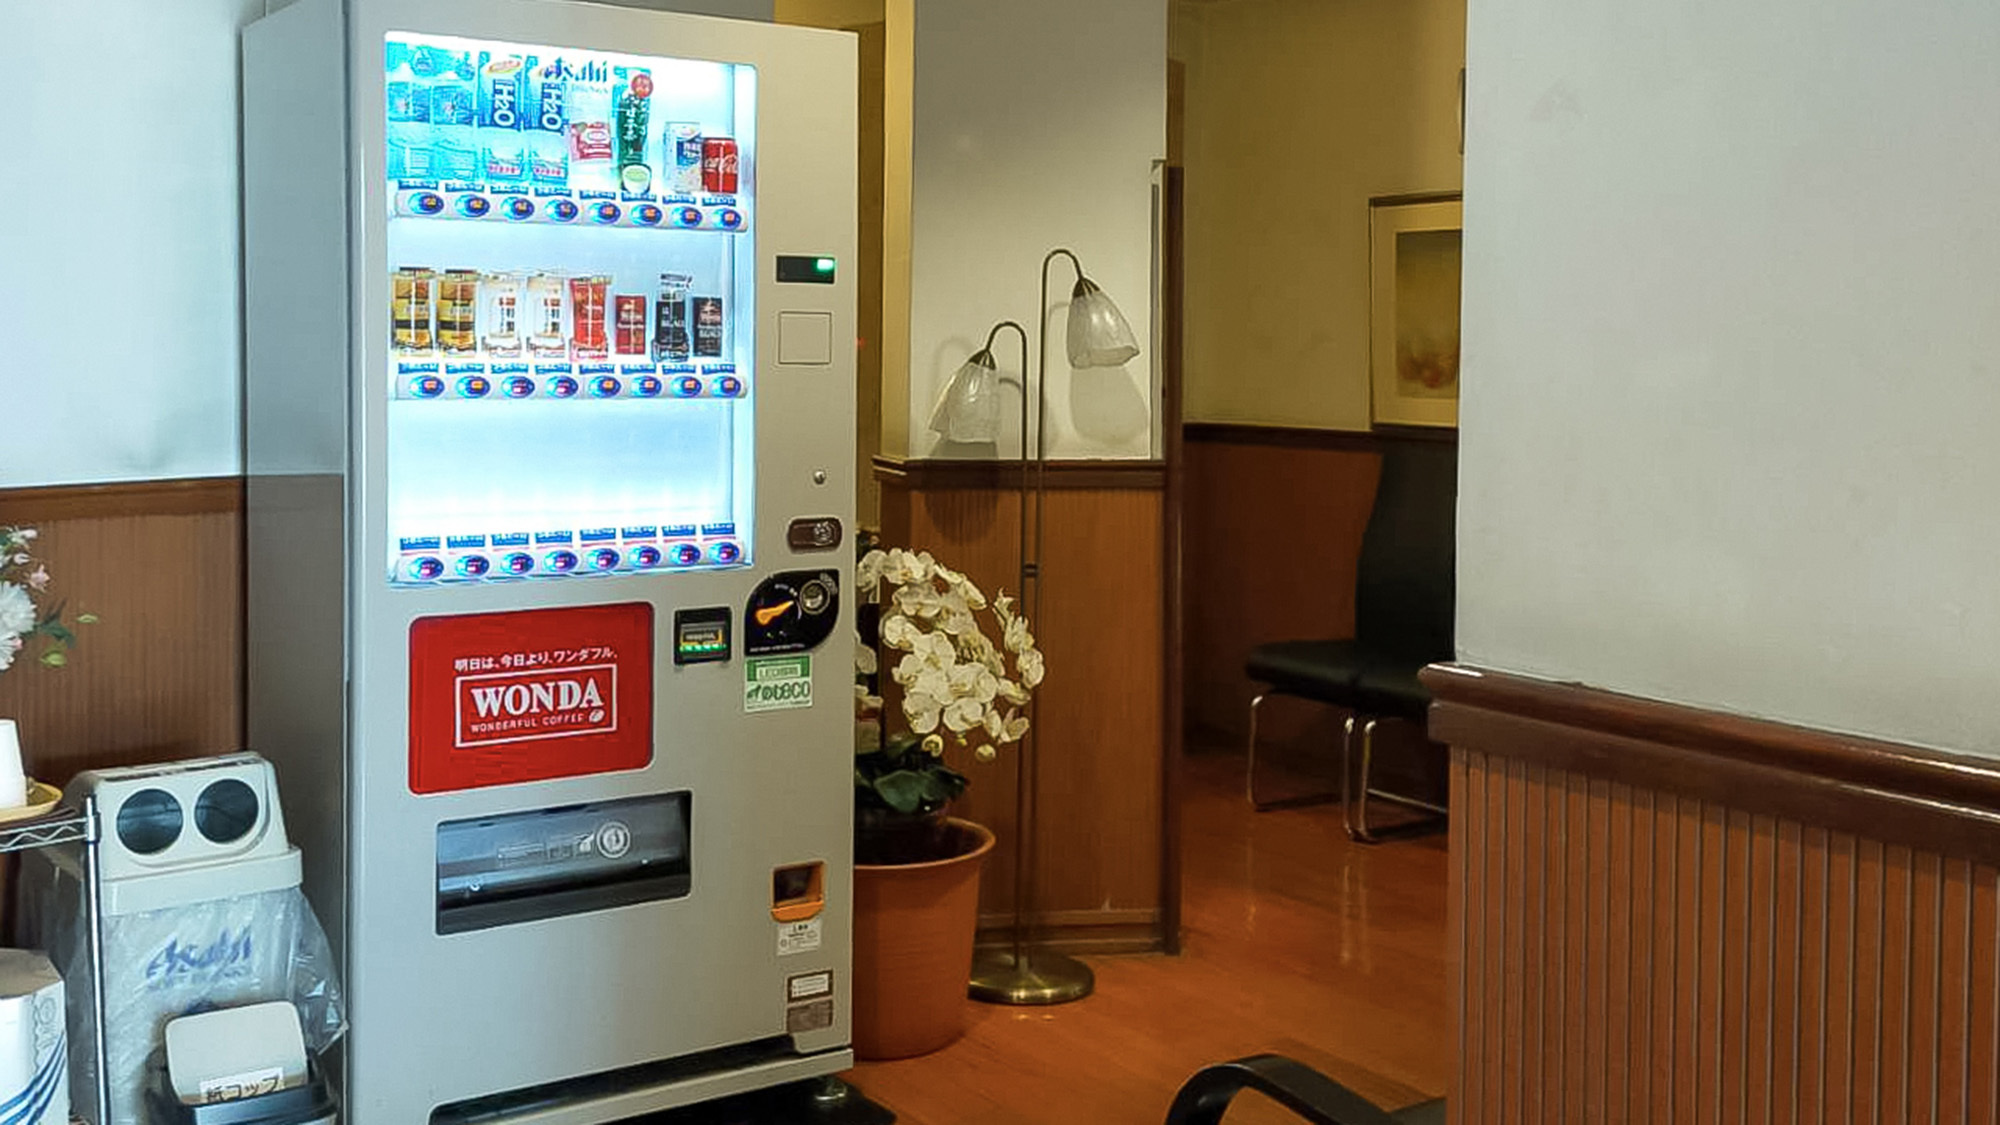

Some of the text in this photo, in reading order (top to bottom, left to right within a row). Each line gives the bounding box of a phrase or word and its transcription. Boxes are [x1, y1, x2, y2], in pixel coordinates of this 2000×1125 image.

[544, 57, 608, 83] Asahi
[470, 677, 604, 718] WONDA
[470, 713, 585, 733] WONDERFUL COFFEE
